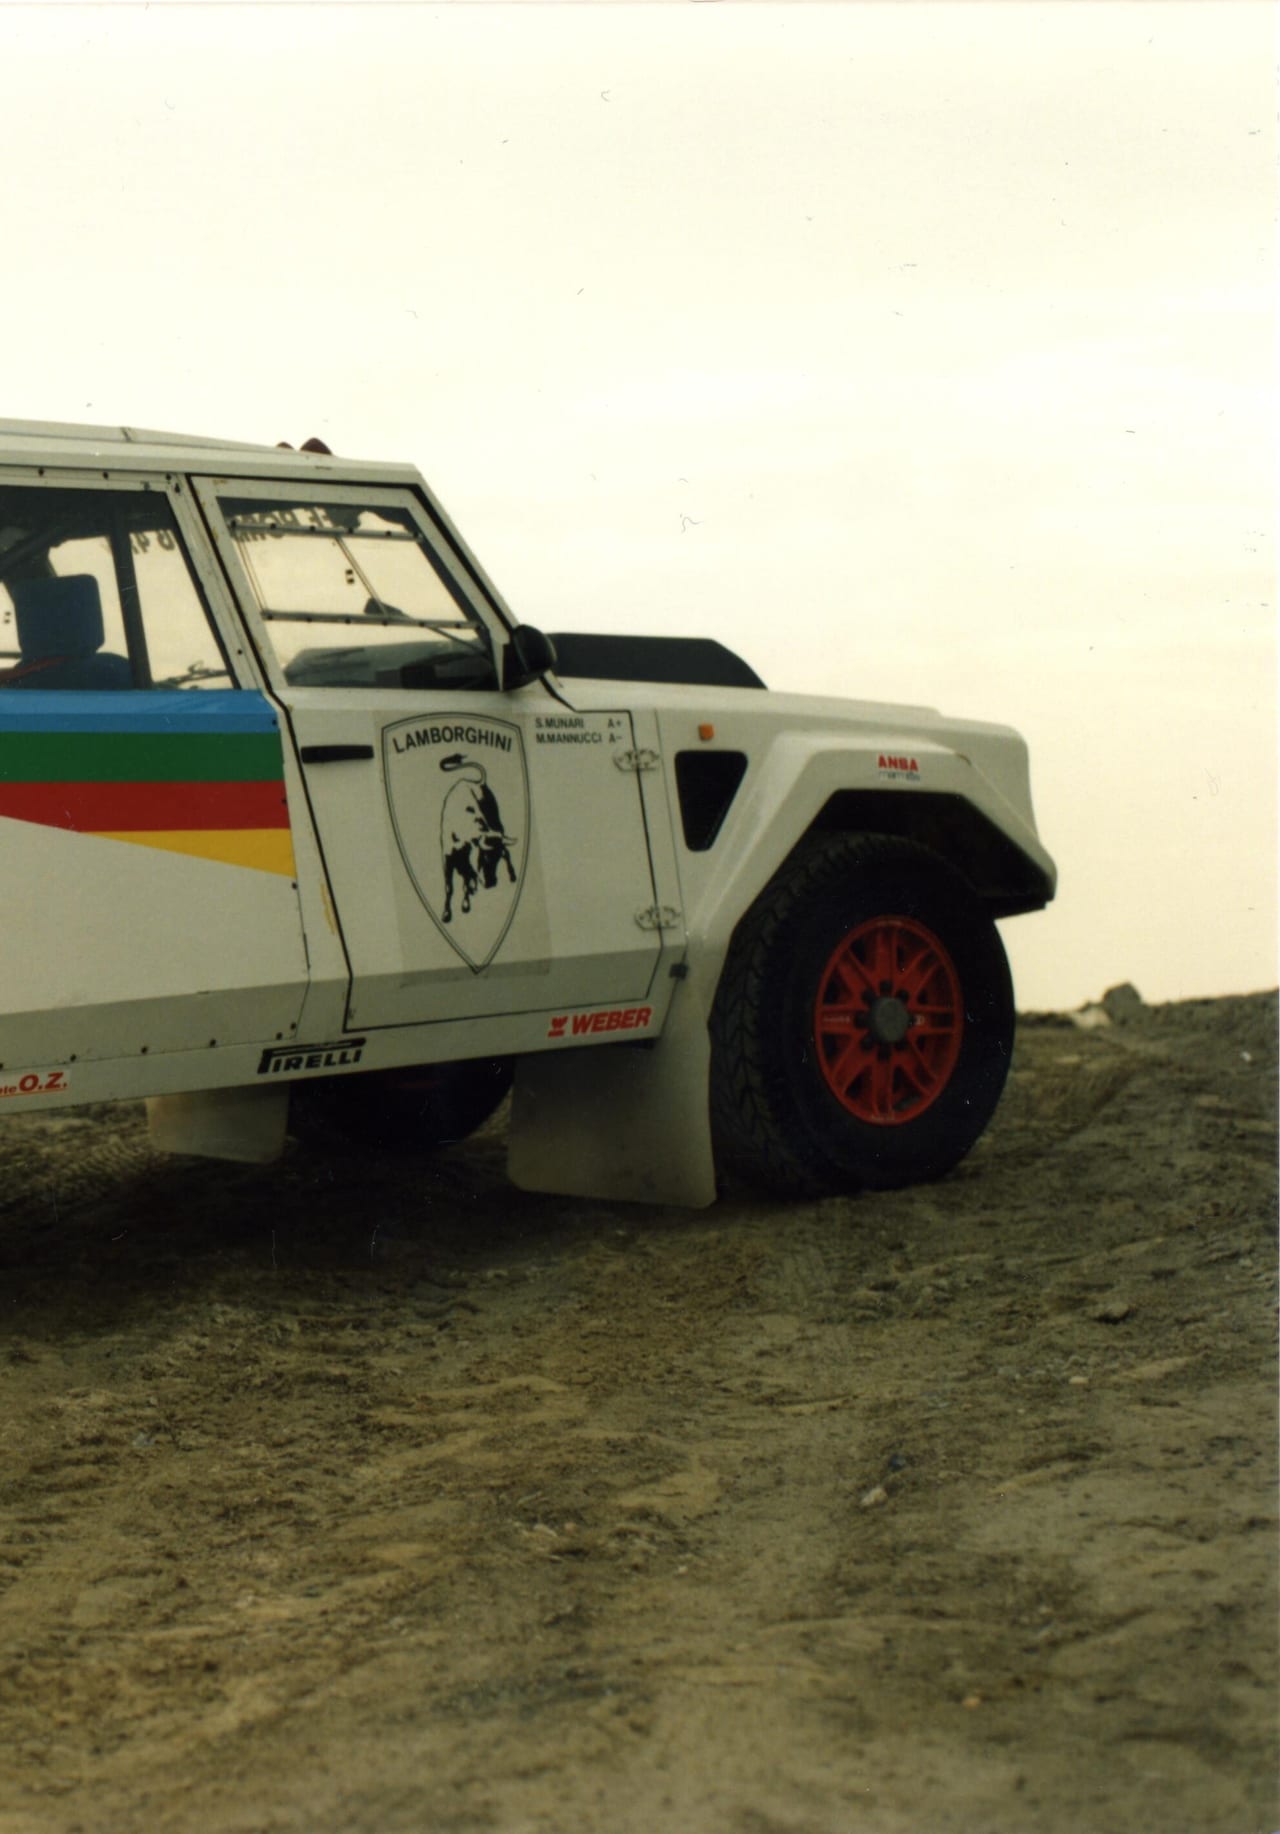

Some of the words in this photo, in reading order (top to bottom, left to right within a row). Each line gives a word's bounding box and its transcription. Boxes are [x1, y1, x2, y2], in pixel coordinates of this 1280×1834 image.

[535, 717, 584, 729] S.MUNARI
[392, 726, 513, 754] LAMBORGHINI
[536, 732, 602, 744] M.MANNUCCI
[571, 1006, 652, 1036] WEBER
[257, 1037, 367, 1074] PIRELLI
